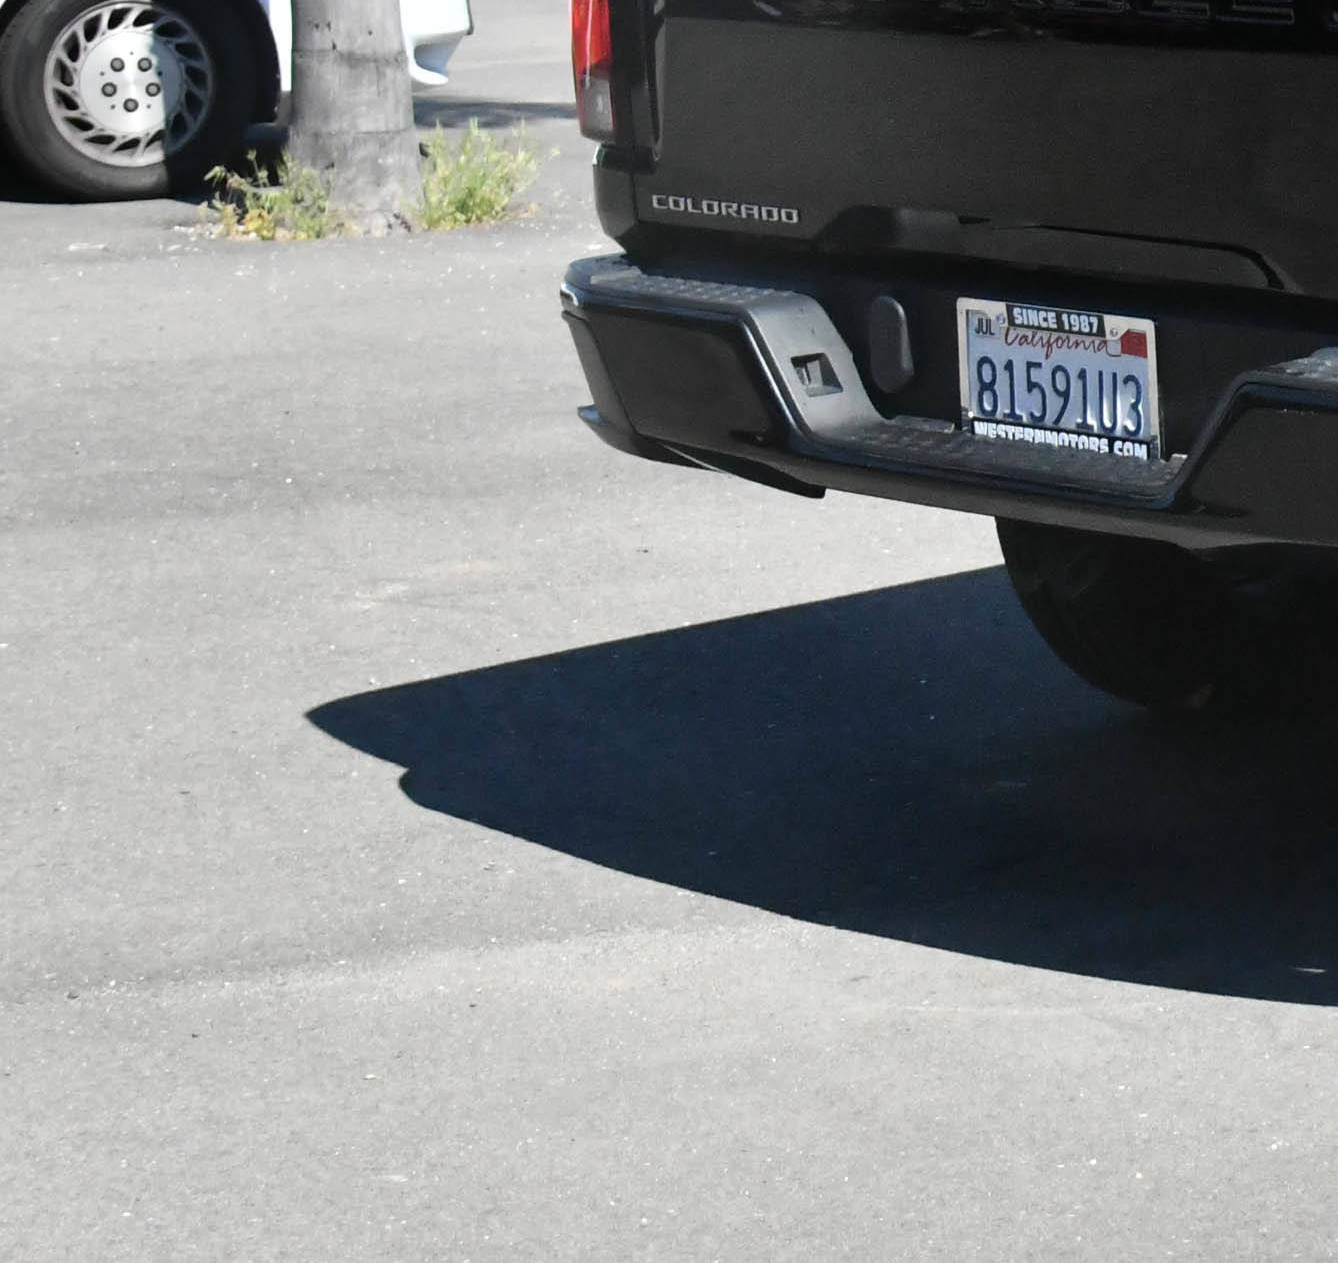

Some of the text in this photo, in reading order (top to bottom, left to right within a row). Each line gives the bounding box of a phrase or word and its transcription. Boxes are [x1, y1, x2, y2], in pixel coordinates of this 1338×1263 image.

[651, 193, 800, 225] COLORADO
[974, 317, 996, 336] JUL
[1012, 306, 1100, 334] SINCE 1987
[1003, 326, 1122, 361] California
[976, 355, 1144, 438] 81591U3
